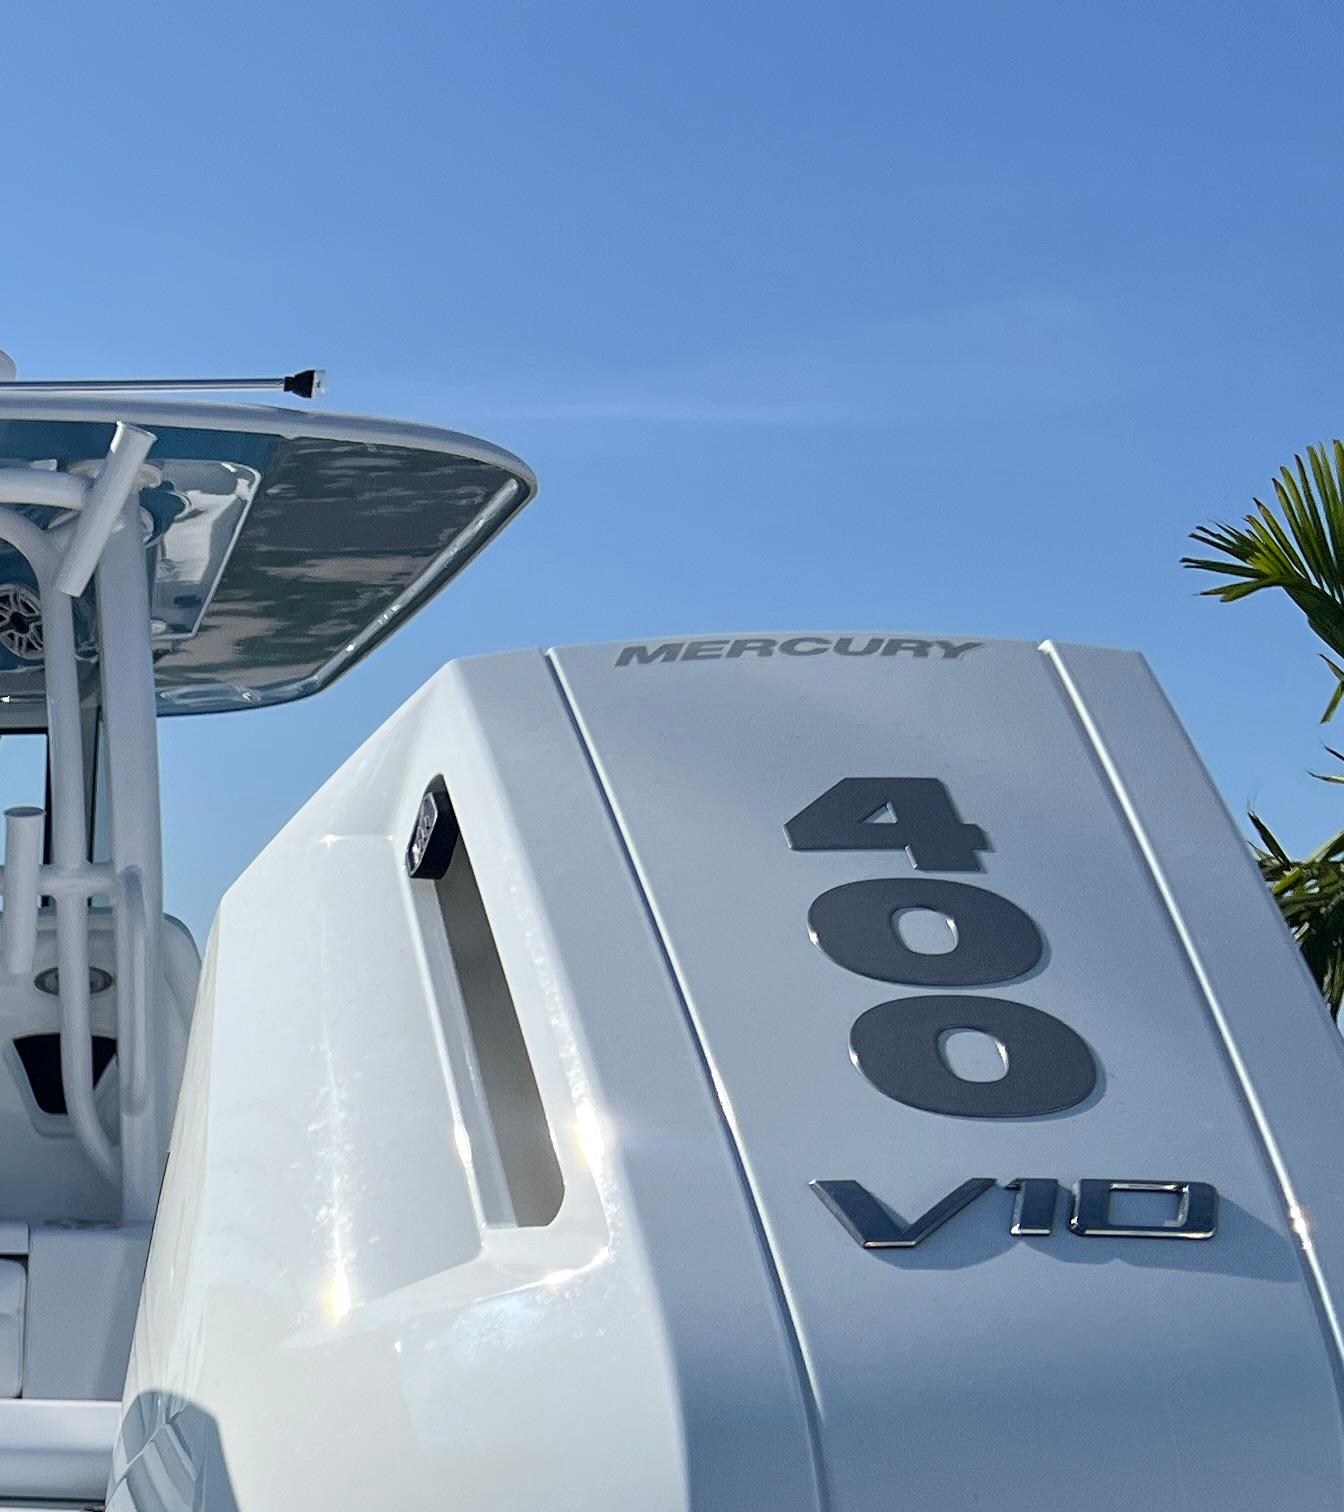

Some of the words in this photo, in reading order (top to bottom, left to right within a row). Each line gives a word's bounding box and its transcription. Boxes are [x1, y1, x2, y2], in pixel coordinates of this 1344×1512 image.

[614, 637, 984, 668] MERCURY
[783, 777, 1098, 1119] 400
[809, 1178, 1219, 1249] V10
